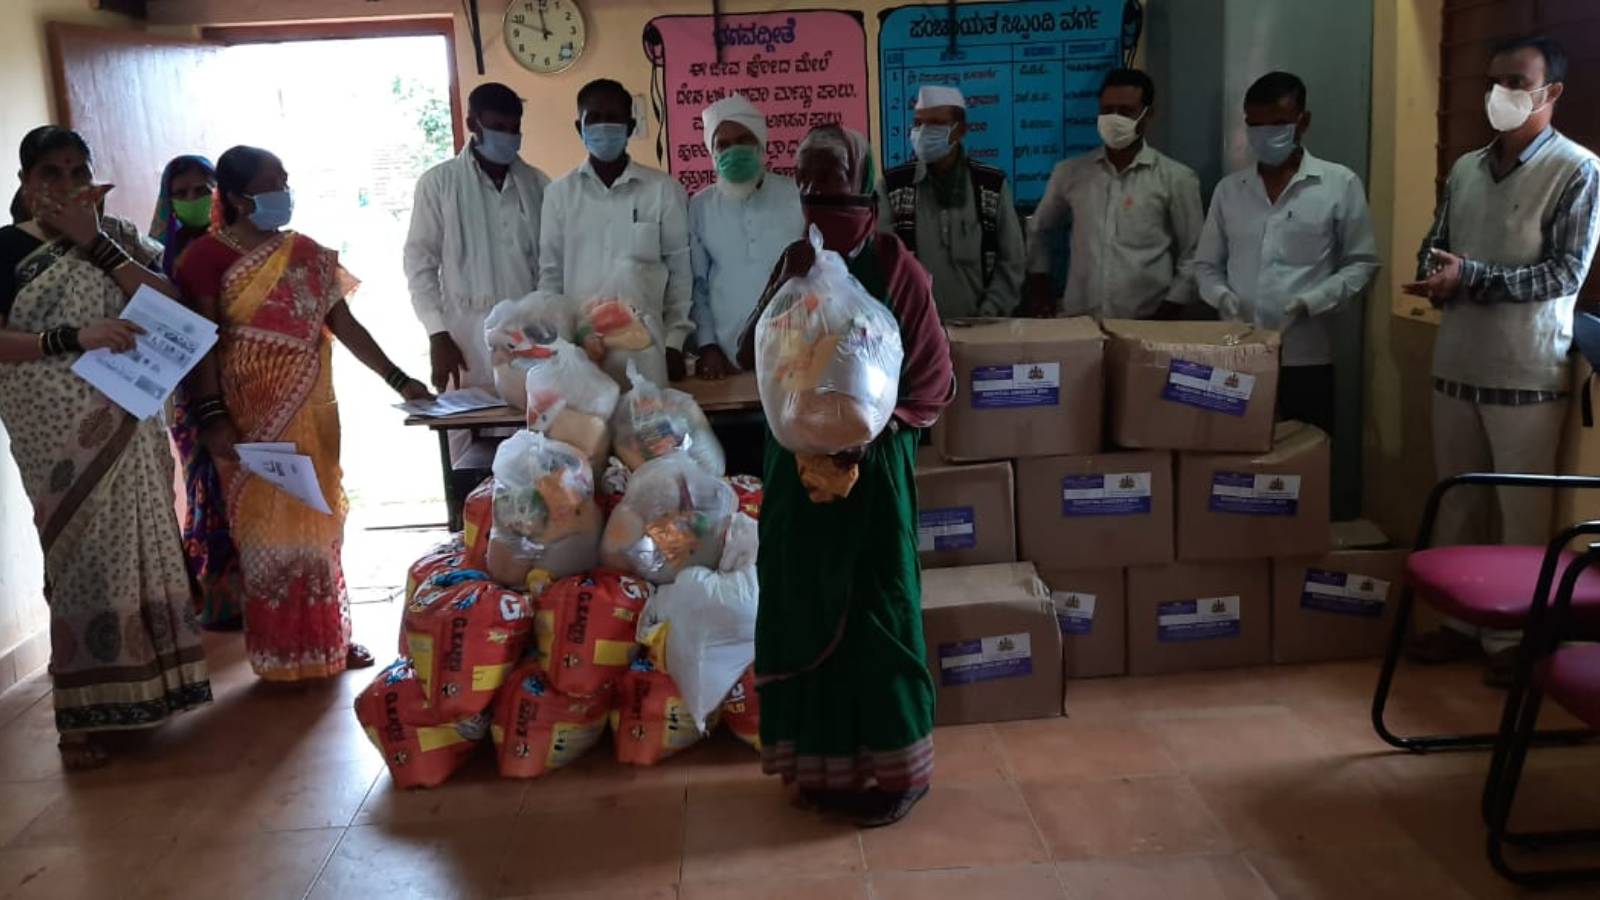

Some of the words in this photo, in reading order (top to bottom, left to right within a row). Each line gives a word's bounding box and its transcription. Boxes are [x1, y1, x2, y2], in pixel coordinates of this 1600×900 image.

[564, 11, 572, 21] 2
[513, 29, 520, 38] 9
[569, 25, 577, 35] 3
[530, 53, 537, 63] 7
[544, 56, 551, 66] 6
